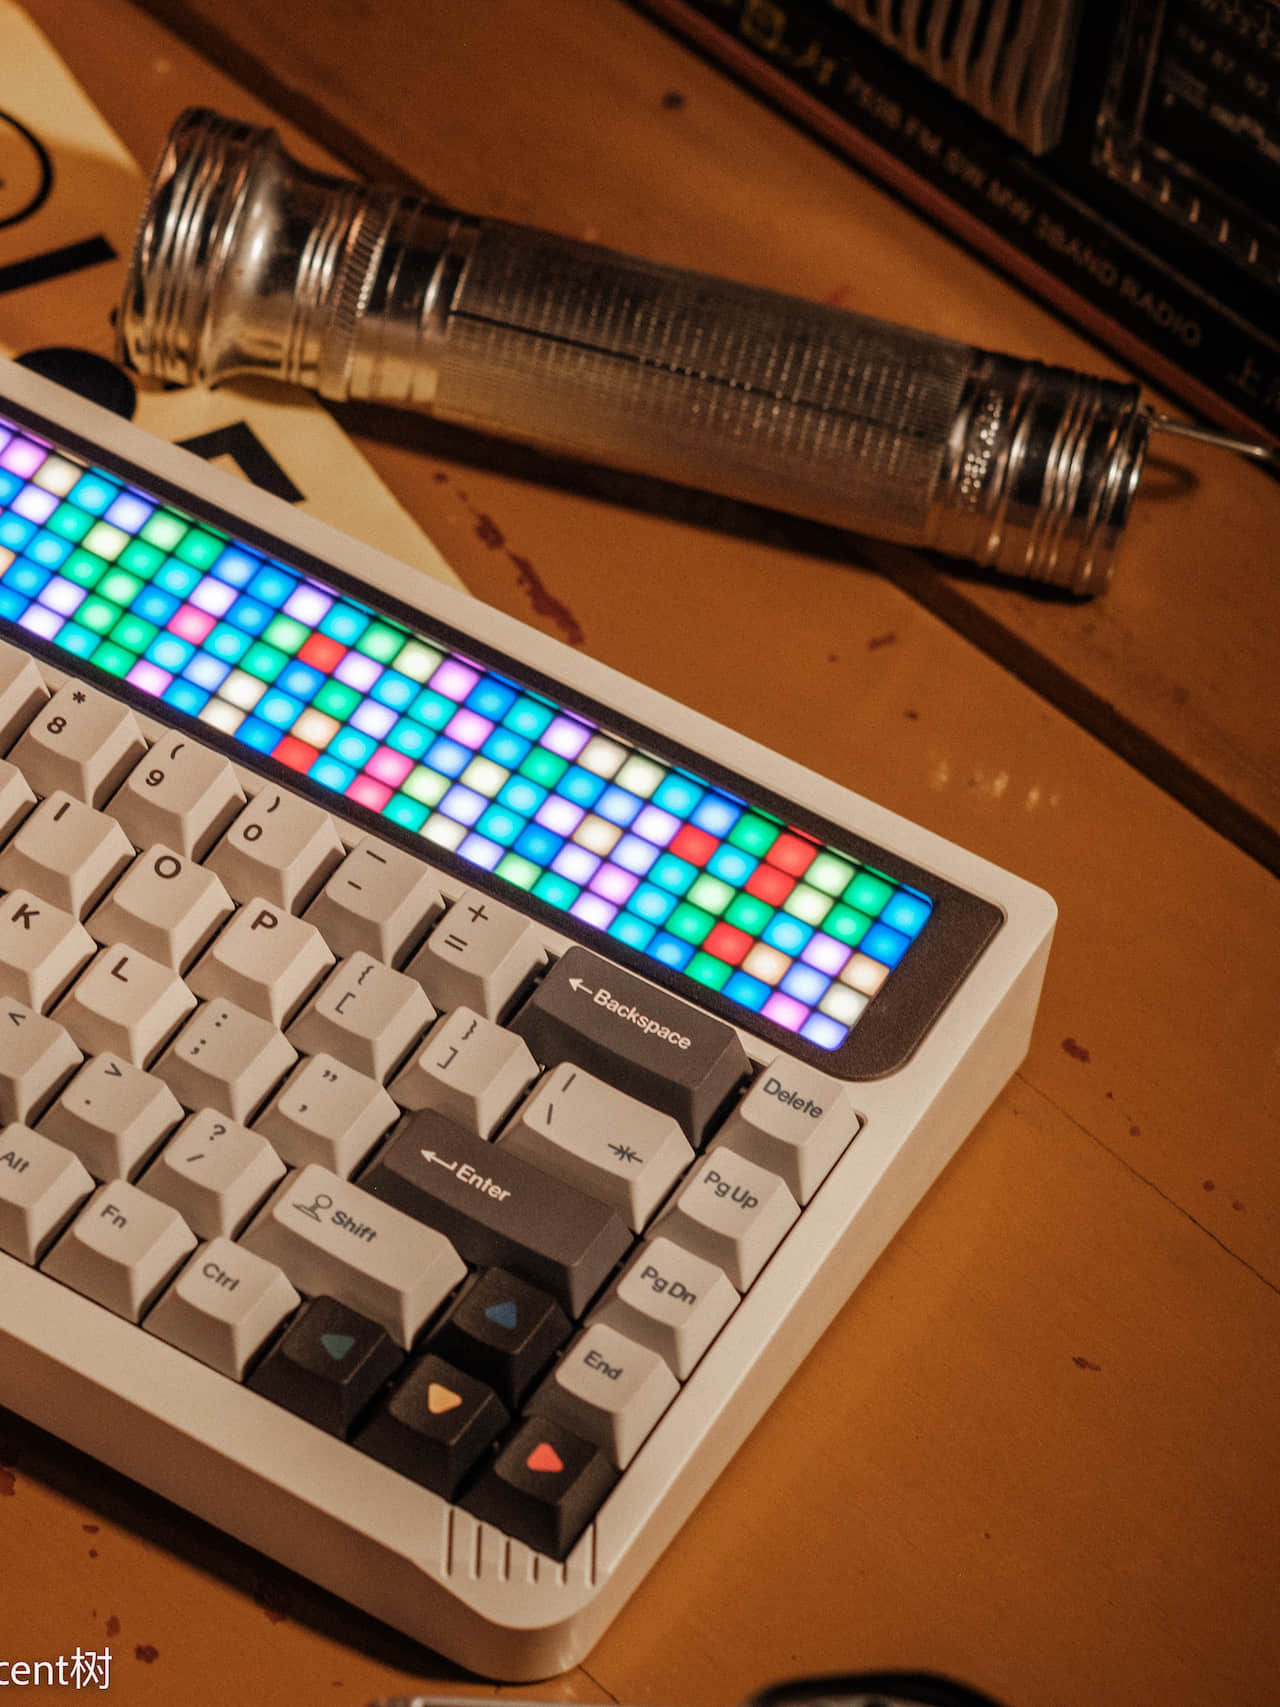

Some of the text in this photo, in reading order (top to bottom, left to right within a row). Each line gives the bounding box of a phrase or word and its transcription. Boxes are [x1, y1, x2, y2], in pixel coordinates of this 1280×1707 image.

[1120, 275, 1202, 348] RADIO
[46, 716, 67, 735] 8
[170, 743, 185, 760] (
[145, 769, 165, 787] 9
[53, 802, 71, 822] I
[266, 796, 281, 813] )
[153, 855, 182, 880] O
[11, 903, 41, 930] K
[250, 909, 279, 931] P
[467, 905, 489, 923] +
[444, 934, 468, 952] =
[110, 956, 129, 983] L
[357, 965, 375, 985] {
[334, 991, 357, 1015] [
[8, 1012, 27, 1027] <
[461, 1019, 478, 1041] }
[593, 988, 692, 1050] Backspace
[104, 1062, 123, 1077] >
[436, 1046, 459, 1070] ]
[762, 1077, 824, 1119] Delete
[209, 1124, 227, 1141] ?
[455, 1163, 511, 1201] Enter
[100, 1204, 127, 1229] Fn
[330, 1210, 377, 1243] Shift
[202, 1263, 240, 1292] Ctrl
[583, 1349, 624, 1381] End
